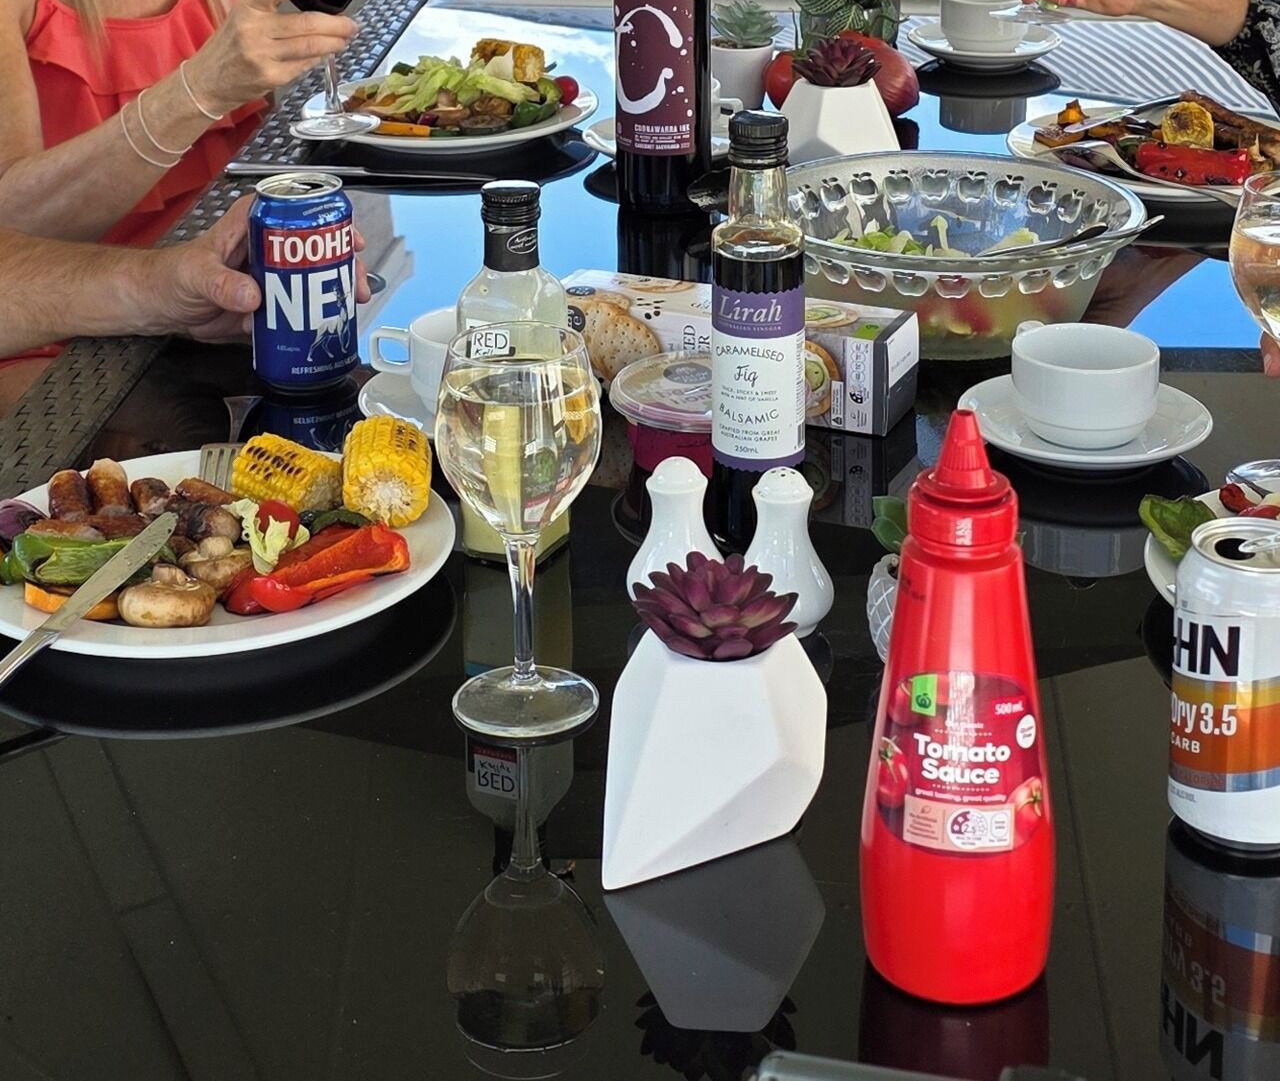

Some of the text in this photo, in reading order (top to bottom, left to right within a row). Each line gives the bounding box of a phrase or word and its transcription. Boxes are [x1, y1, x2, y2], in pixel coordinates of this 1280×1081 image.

[473, 332, 508, 350] RED
[716, 345, 785, 362] CARAMELISED
[734, 364, 759, 388] Fig
[719, 402, 780, 425] BALSAMIC
[1172, 616, 1241, 677] HN
[1200, 702, 1239, 737] 3.5
[913, 732, 1011, 762] Tomato
[921, 758, 1000, 784] Sauce
